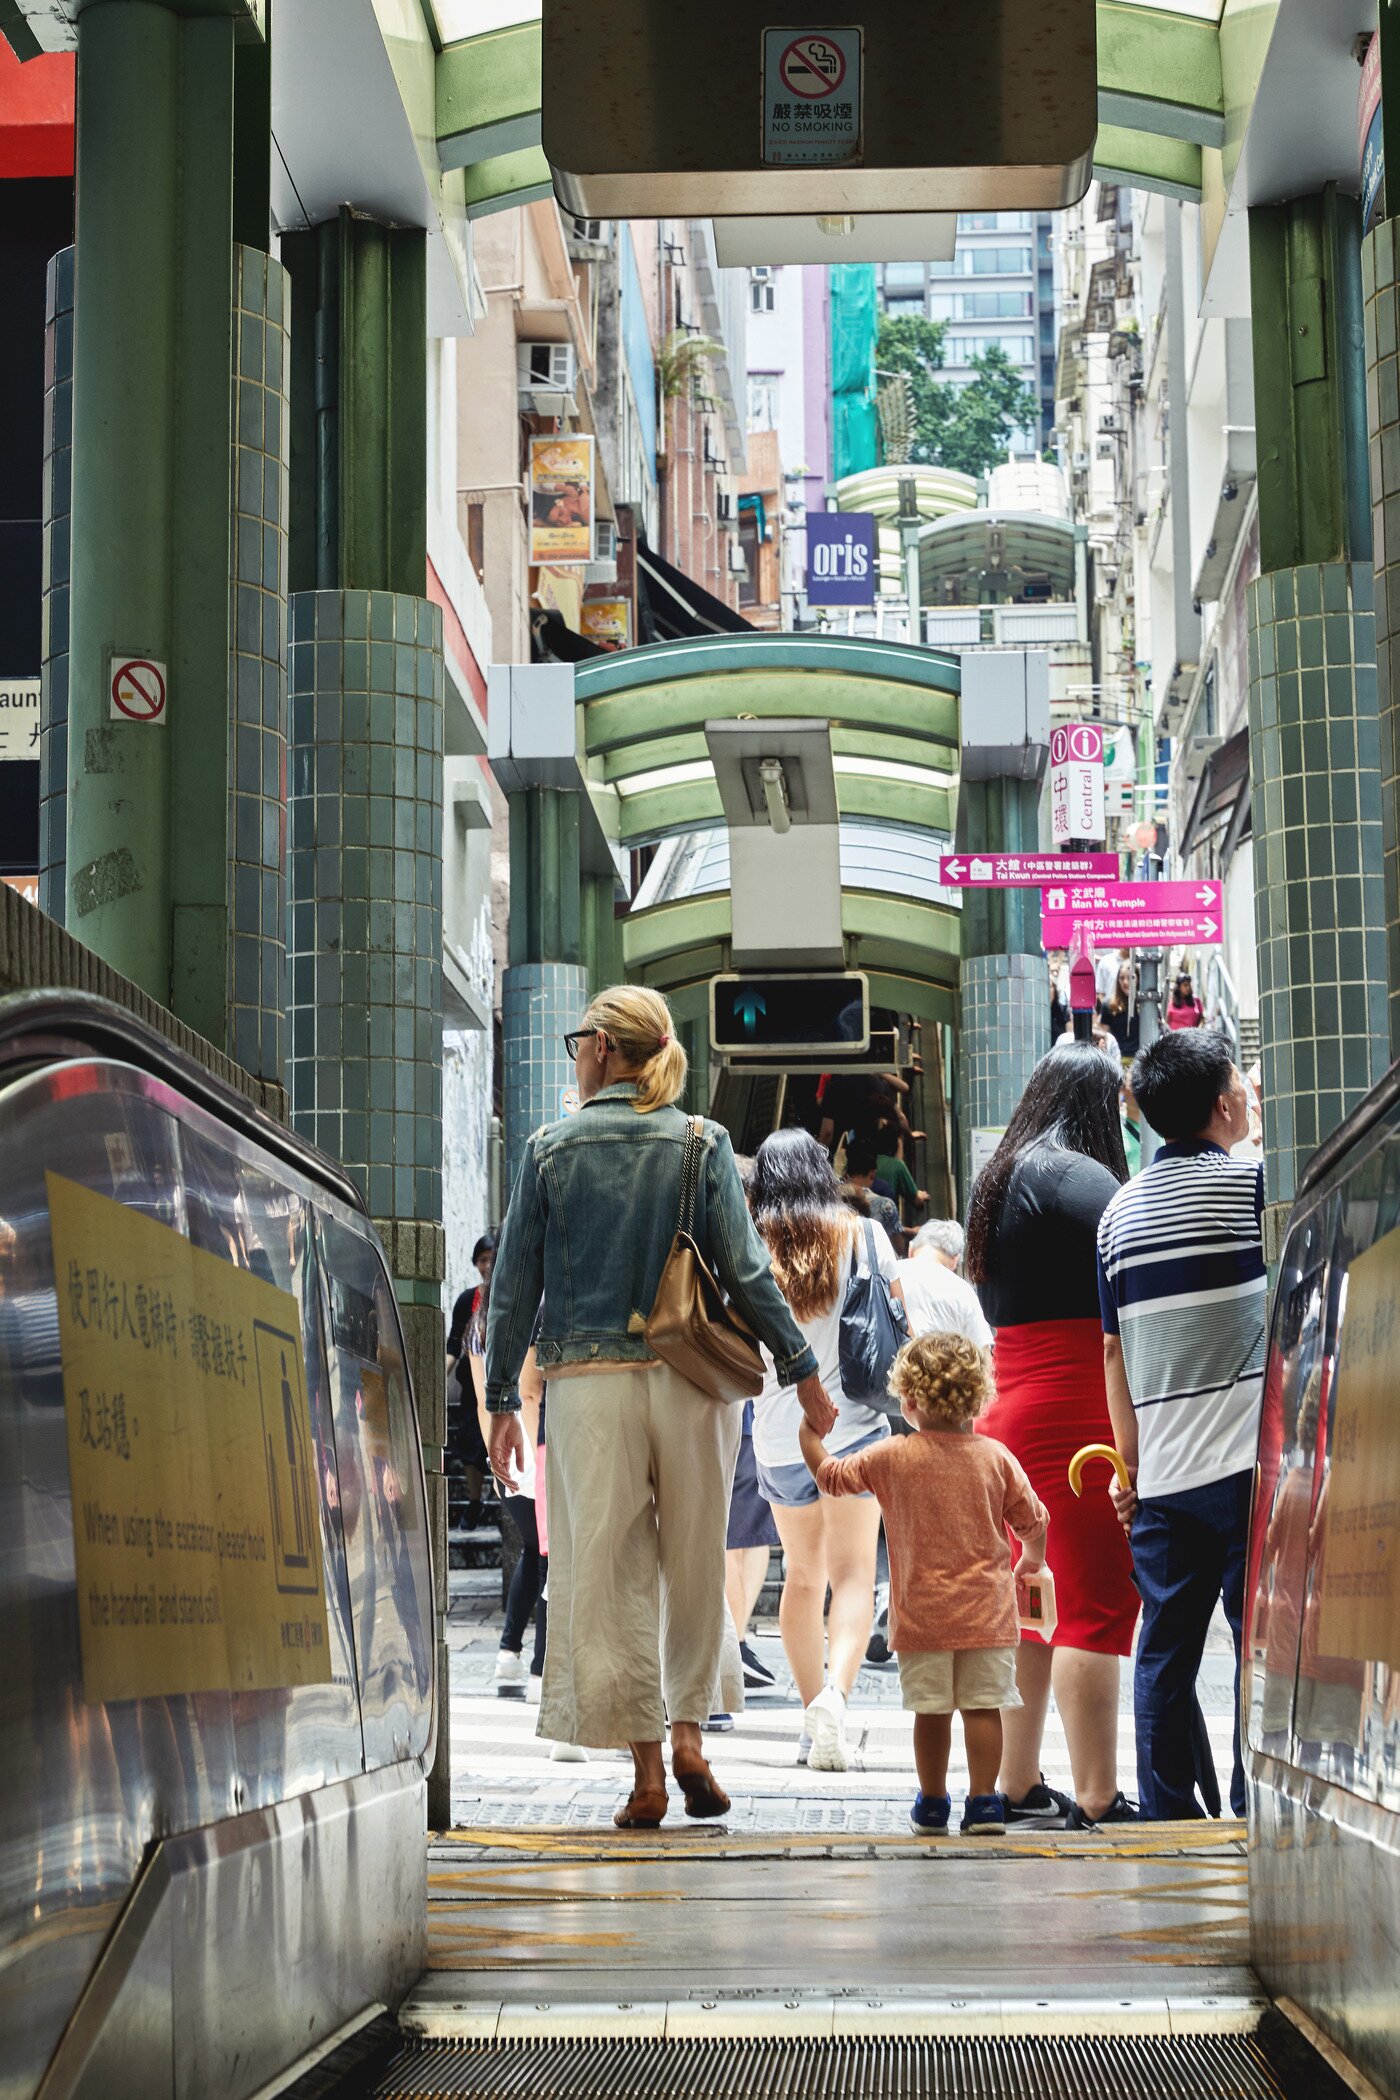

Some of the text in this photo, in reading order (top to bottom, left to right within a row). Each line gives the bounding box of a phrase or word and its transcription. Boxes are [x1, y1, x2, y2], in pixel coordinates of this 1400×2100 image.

[772, 102, 853, 120] 嚴禁吸煙
[772, 121, 853, 132] NO SMOKING
[813, 533, 868, 576] oris
[1079, 769, 1093, 830] Central
[996, 872, 1008, 880] Tai
[1009, 871, 1031, 880] Kwun
[1072, 898, 1146, 910] Man Mo Temple
[82, 1502, 119, 1545] When
[122, 1506, 151, 1559] using
[153, 1507, 173, 1549] the
[216, 1520, 247, 1567] please
[247, 1521, 266, 1561] hold
[88, 1581, 109, 1626] the
[110, 1581, 157, 1625] handrail
[158, 1583, 177, 1625] and
[177, 1584, 203, 1625] stand
